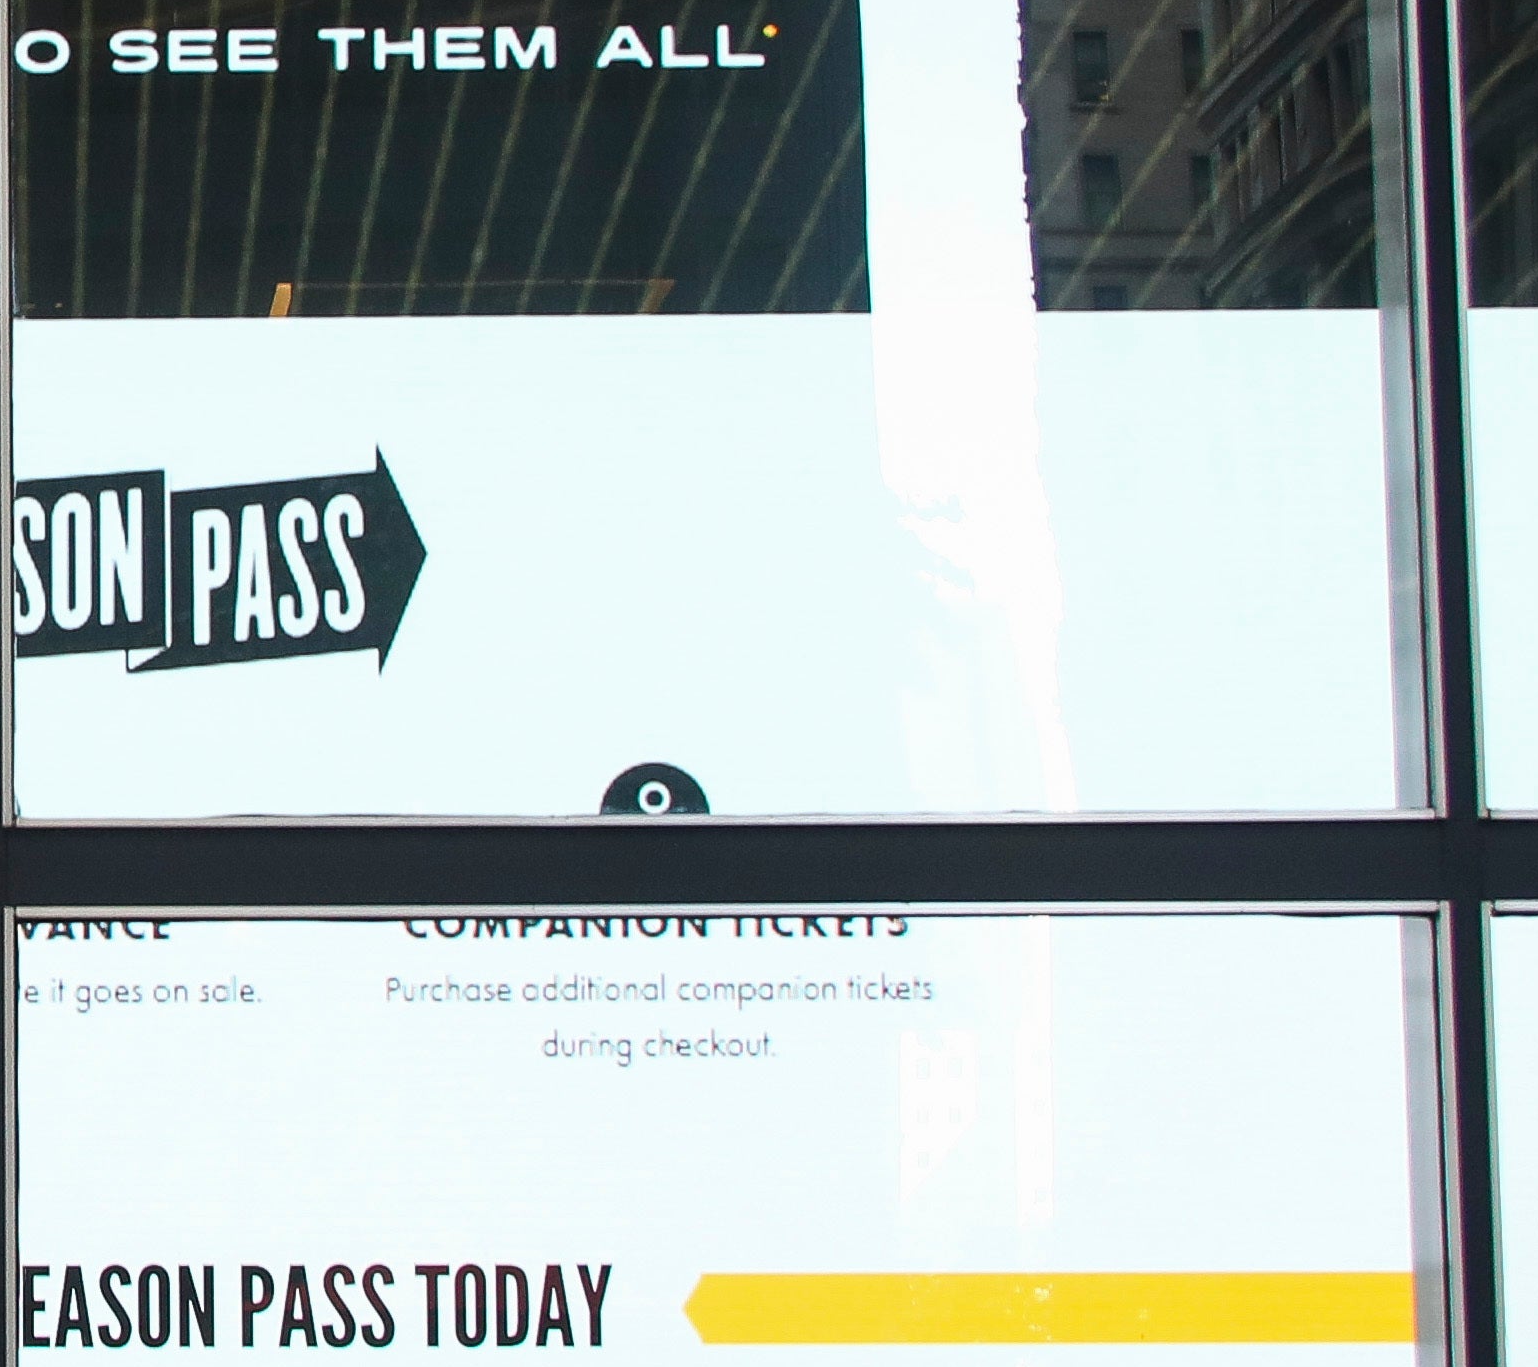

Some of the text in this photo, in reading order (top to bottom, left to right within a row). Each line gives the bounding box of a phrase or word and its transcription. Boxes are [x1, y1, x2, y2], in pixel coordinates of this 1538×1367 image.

[15, 30, 69, 73] O
[110, 29, 278, 72] SEE
[318, 26, 556, 70] THEM
[193, 494, 366, 646] PASS
[52, 979, 65, 1002] it
[75, 985, 143, 1014] goes
[153, 985, 188, 1003] on
[199, 976, 262, 1003] sale.
[386, 973, 933, 1011] Purchase additional companion tickets
[542, 1029, 775, 1067] during checkout.
[22, 1265, 214, 1347] EASON
[241, 1264, 395, 1347] PASS
[415, 1264, 612, 1347] TODAY
